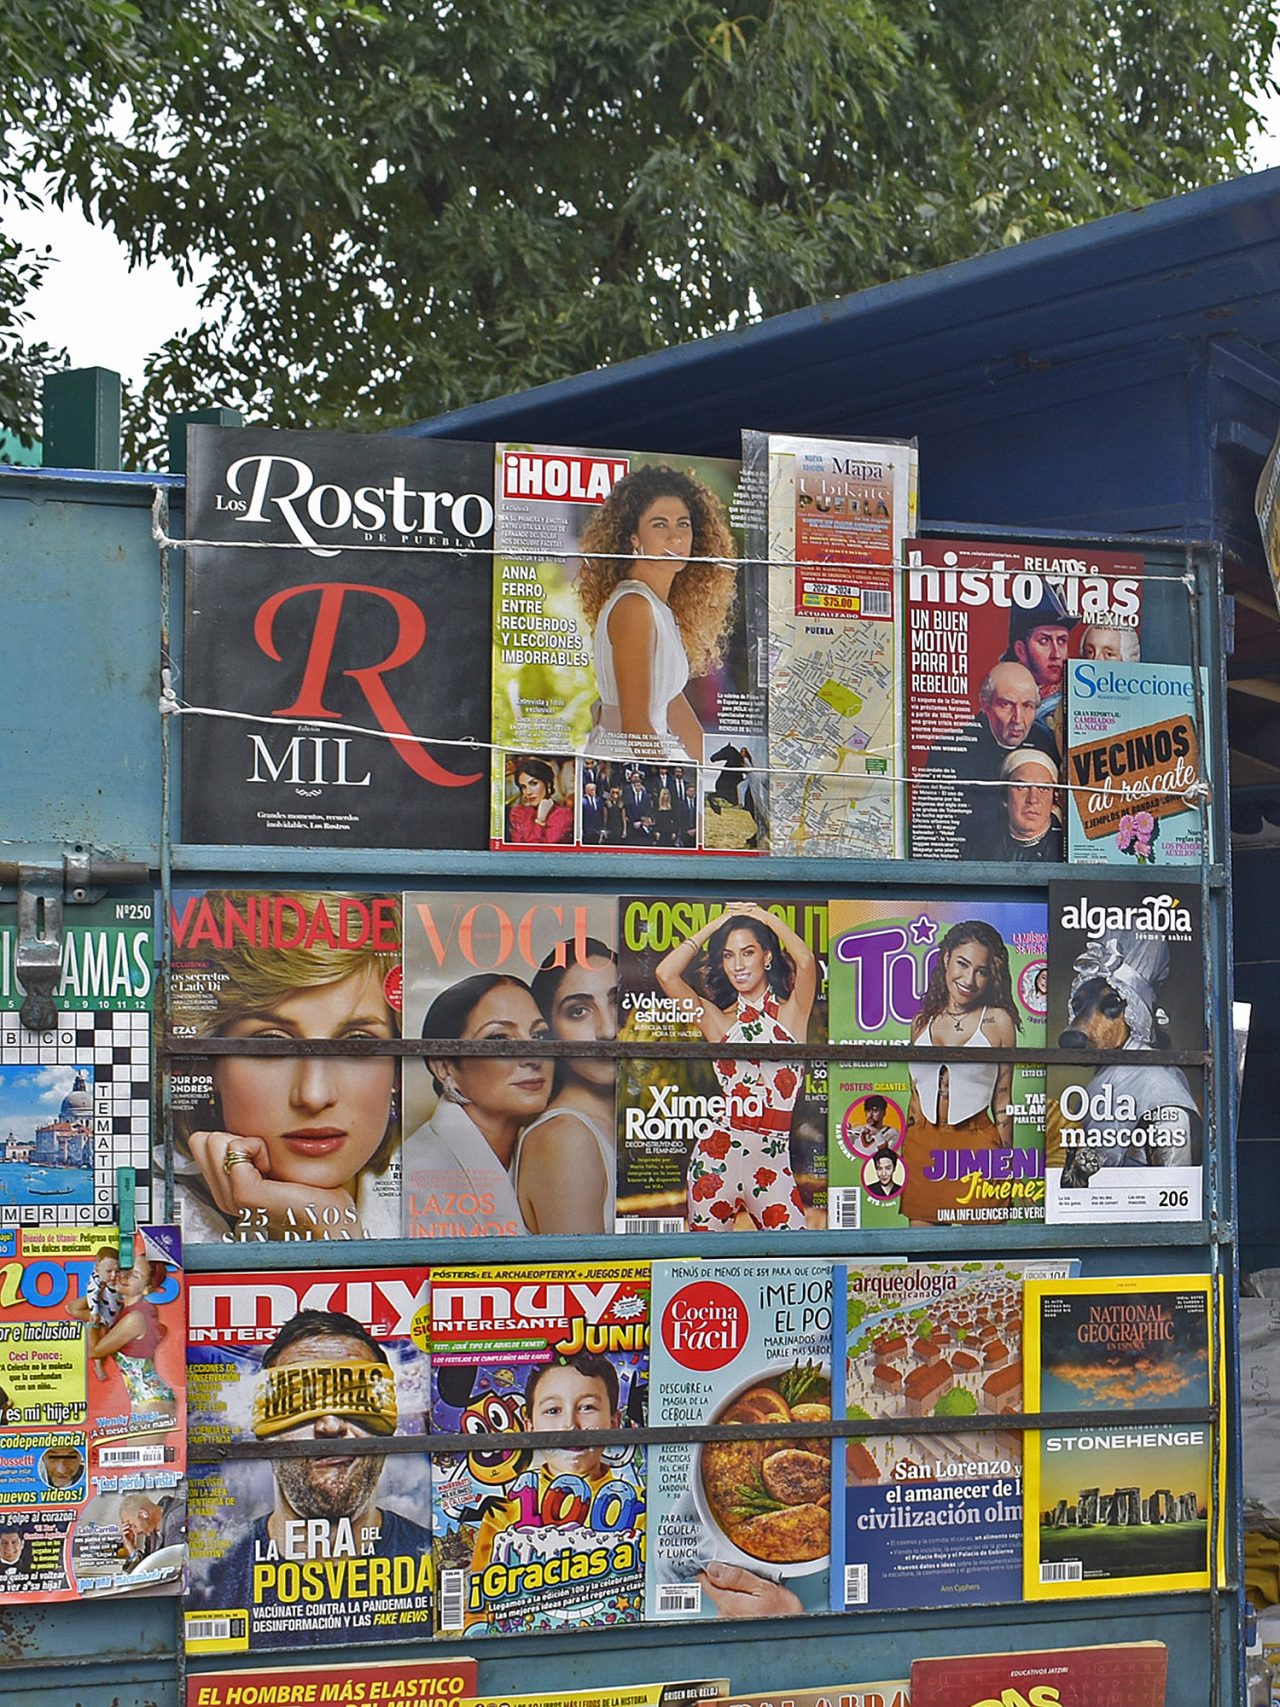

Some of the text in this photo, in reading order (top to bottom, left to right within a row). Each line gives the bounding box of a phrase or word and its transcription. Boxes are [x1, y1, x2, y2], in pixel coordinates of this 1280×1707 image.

[832, 458, 883, 480] Mapa
[216, 495, 247, 512] Los
[364, 533, 476, 548] DE PUEBLA
[502, 566, 537, 580] ANNA
[1025, 557, 1086, 574] RELATOS
[502, 582, 546, 598] FERRO,
[502, 600, 543, 613] ENTRE
[824, 597, 852, 608] $75.00
[501, 616, 576, 632] RECUERDOS
[798, 611, 859, 619] ACTUALIZADO
[911, 609, 968, 631] UN BUEN
[1083, 609, 1139, 627] MÉXICO
[805, 626, 834, 635] PUEBLA
[502, 633, 582, 649] Y LECCIONES
[912, 630, 968, 653] MOTIVO
[502, 650, 589, 666] IMBORRABLES
[912, 652, 968, 674] PARA LA
[253, 582, 483, 788] R
[912, 671, 968, 694] REBELIÓN
[246, 734, 371, 786] MIL
[1072, 725, 1190, 786] VECINOS
[1088, 756, 1195, 814] al rescate
[115, 905, 151, 920] Nº250
[1061, 894, 1192, 938] algarabía
[624, 901, 829, 953] COSMOLIT
[622, 992, 693, 1010] ¿Volver a
[635, 1007, 704, 1023] estudiar?
[840, 1083, 872, 1091] POSTERS
[647, 1085, 764, 1118] Ximena
[1060, 1084, 1178, 1122] Oda a las
[625, 1108, 712, 1140] Romo
[1060, 1124, 1186, 1147] mascotas
[956, 1171, 1045, 1204] Jiménez
[409, 1193, 495, 1216] LAZOS
[1159, 1191, 1189, 1207] 206
[238, 1204, 359, 1227] 25 AÑOS
[671, 1267, 698, 1278] MENÚS
[701, 1268, 711, 1277] DE
[715, 1267, 741, 1277] MENOS
[743, 1268, 753, 1277] DE
[757, 1267, 769, 1277] $59
[772, 1267, 791, 1276] PARA
[795, 1267, 809, 1276] QUE
[853, 1269, 957, 1298] arqueología
[433, 1283, 621, 1325] muy
[883, 1290, 931, 1299] mexicana
[189, 1280, 431, 1335] muy
[671, 1300, 738, 1320] Cocina
[1090, 1304, 1166, 1323] NATIONAL
[432, 1317, 569, 1331] INTERESANTE
[775, 1311, 795, 1333] EL
[672, 1320, 738, 1350] Fácil
[1077, 1321, 1175, 1343] GEOGRAPHIC
[9, 1351, 62, 1361] Ceci Ponce:
[660, 1383, 713, 1394] DESCUBRE LA
[689, 1397, 698, 1405] DE
[700, 1397, 709, 1405] LA
[661, 1408, 702, 1421] CEBOLLA
[0, 1432, 85, 1450] codependencia!
[1046, 1432, 1204, 1452] STONEHENGE
[672, 1464, 689, 1472] CHEF
[895, 1460, 1022, 1480] San Lorenzo y
[662, 1473, 687, 1483] OMAR
[659, 1484, 690, 1493] SANDOVAL
[886, 1479, 1023, 1504] el amanecer de l
[509, 1471, 637, 1533] 100
[660, 1514, 694, 1523] PARA LA
[857, 1501, 980, 1531] civilización
[255, 1517, 357, 1561] LA ERA
[361, 1526, 382, 1541] DEL
[658, 1525, 699, 1536] ESCUELA:
[361, 1543, 375, 1556] LA
[660, 1537, 697, 1547] ROLLITOS
[657, 1548, 698, 1559] Y LUNCH
[253, 1554, 434, 1604] POSVERDA
[468, 1543, 634, 1610] ¡Gracias a
[940, 1583, 980, 1593] Ann Cyphers
[253, 1597, 427, 1619] VACÚNATE CONTRA LA PANDEMIA DE
[253, 1610, 429, 1633] DESINFORMACIÓN Y LAS FAKE NEWS
[197, 1687, 223, 1706] EL
[225, 1684, 317, 1705] HOMBRE
[320, 1680, 366, 1702] MÁS
[369, 1677, 465, 1700] ELASTICO
